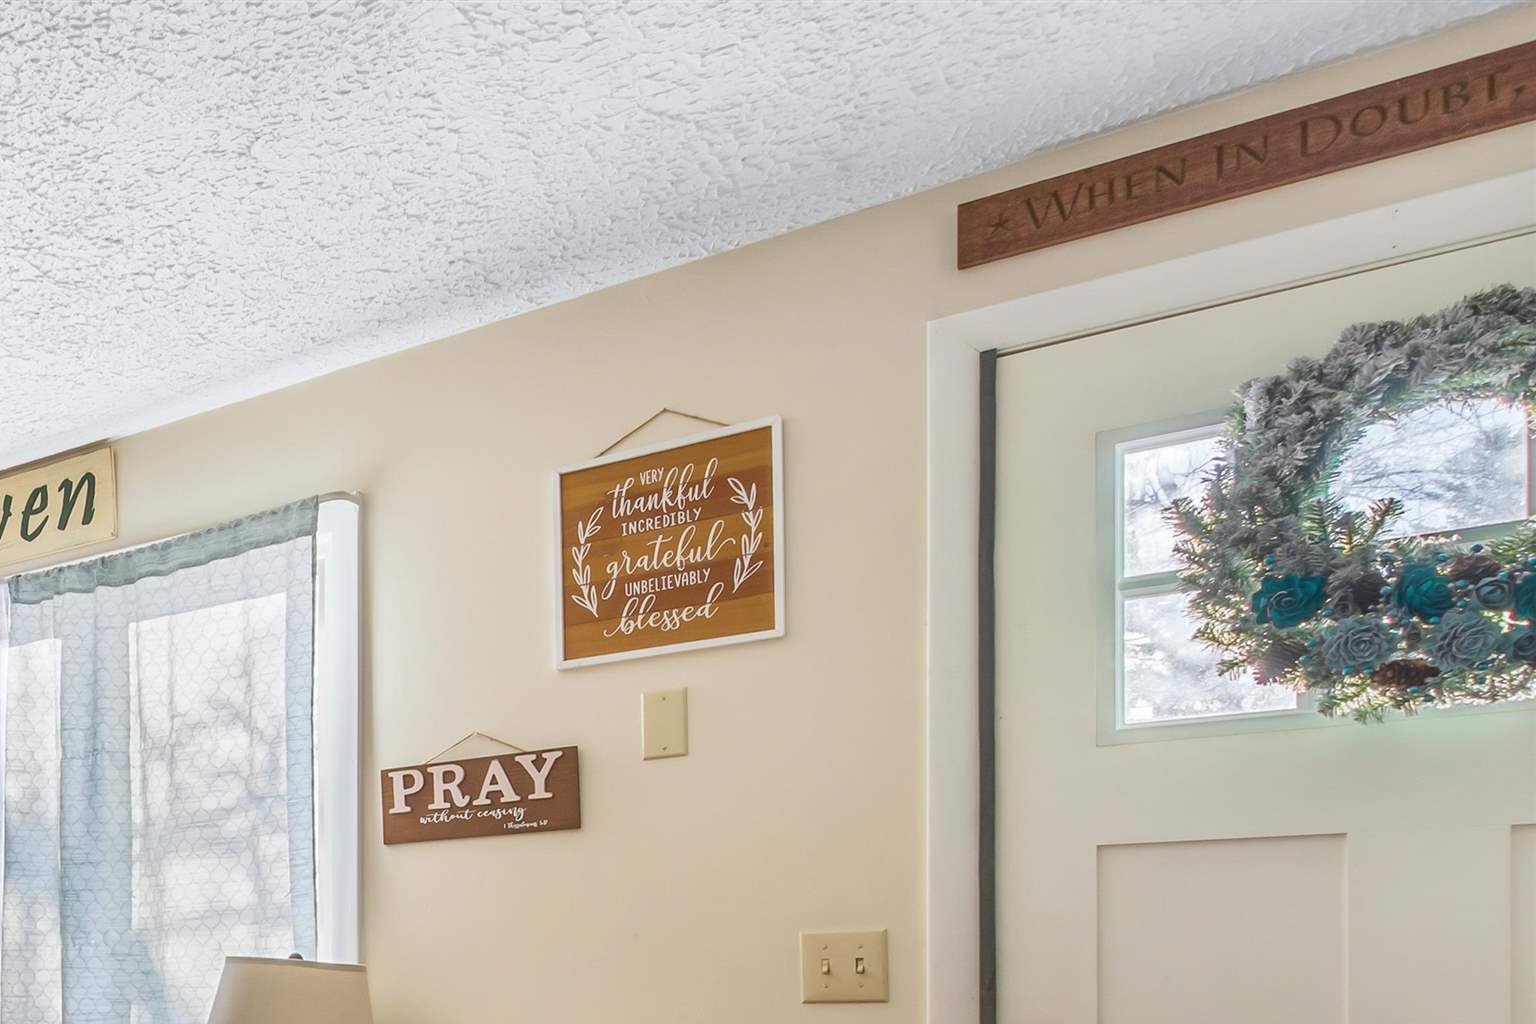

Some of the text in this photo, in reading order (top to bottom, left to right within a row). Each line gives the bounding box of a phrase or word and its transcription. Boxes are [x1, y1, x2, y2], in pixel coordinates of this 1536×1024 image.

[1025, 64, 1525, 230] WHEN IN DOUBT,
[607, 457, 719, 519] thankful
[639, 467, 664, 486] VERY
[621, 507, 702, 536] INCREDIBLY
[601, 519, 736, 601] grateful
[625, 568, 711, 597] UNBELIEVABLY
[603, 582, 725, 637] blessed
[388, 751, 563, 814] PRAY
[419, 806, 526, 825] without ceasing
